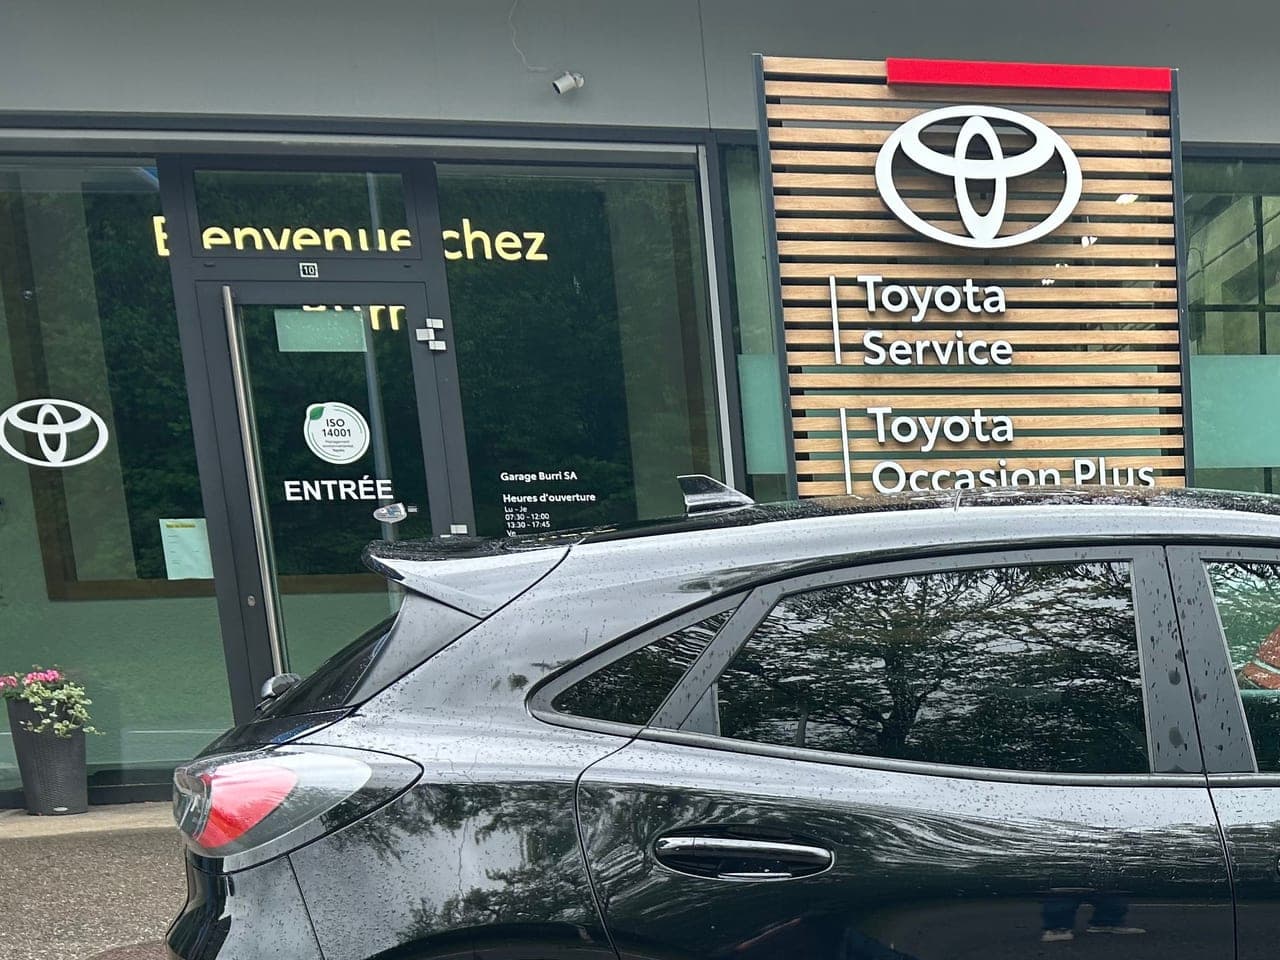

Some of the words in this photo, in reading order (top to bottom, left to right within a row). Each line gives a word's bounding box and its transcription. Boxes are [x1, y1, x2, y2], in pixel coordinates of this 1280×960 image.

[443, 218, 549, 261] chez
[303, 265, 316, 275] 10
[856, 274, 1006, 323] Toyota
[862, 330, 1013, 366] Service
[326, 418, 345, 428] ISO
[322, 428, 352, 437] 14001
[866, 406, 1014, 452] Toyota
[500, 472, 537, 482] Garage
[538, 471, 562, 481] Burri
[564, 471, 578, 480] SA
[871, 458, 1061, 495] Occasion
[1073, 457, 1156, 489] Plus
[283, 475, 394, 501] ENTRÉE
[502, 493, 538, 503] Heures
[539, 493, 597, 502] d'ouverture
[504, 513, 525, 521] 07:30
[506, 521, 526, 529] 13:30
